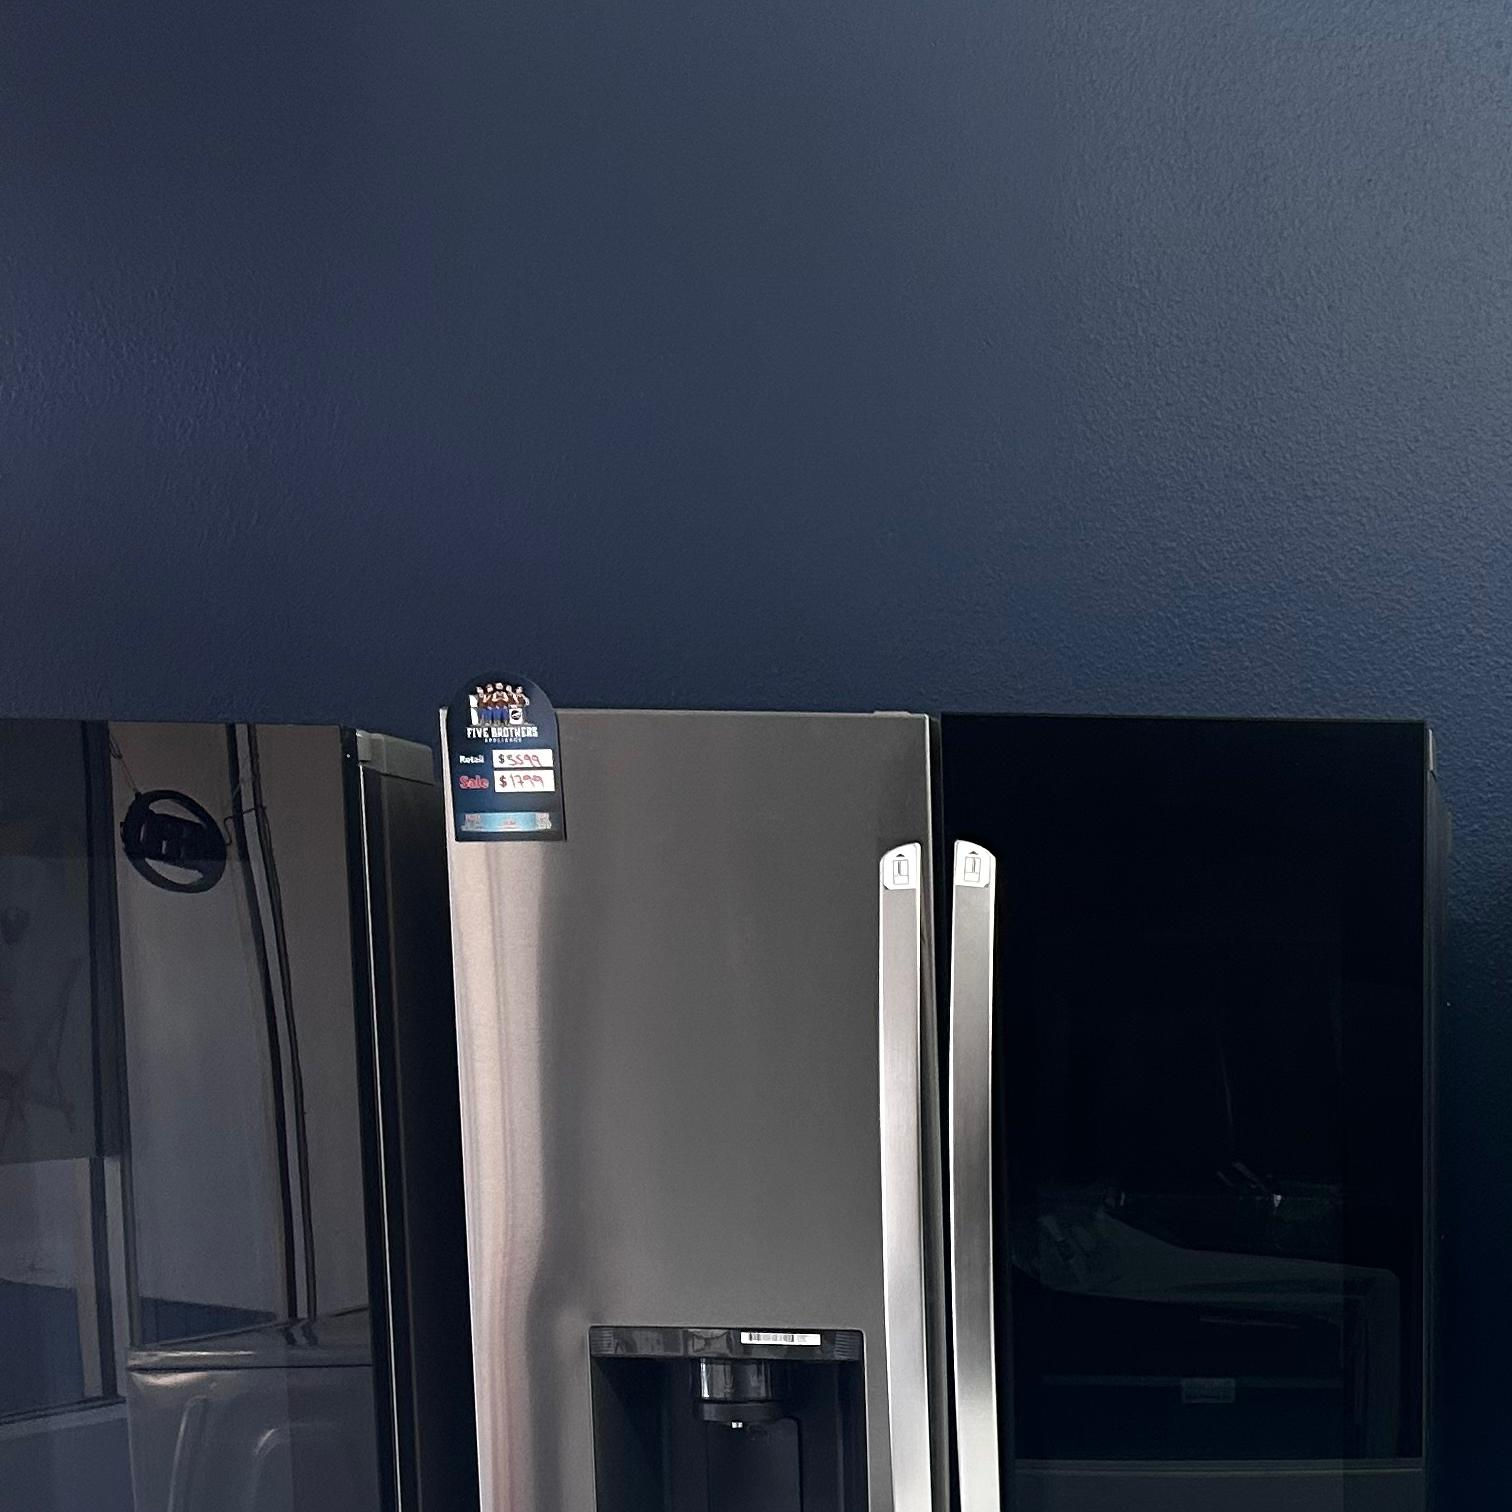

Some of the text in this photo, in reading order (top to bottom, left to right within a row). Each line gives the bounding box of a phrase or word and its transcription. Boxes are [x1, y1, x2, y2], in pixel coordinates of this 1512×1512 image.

[466, 726, 538, 738] FIVE BROTHERS
[460, 755, 485, 764] Retail
[458, 775, 489, 789] Sale
